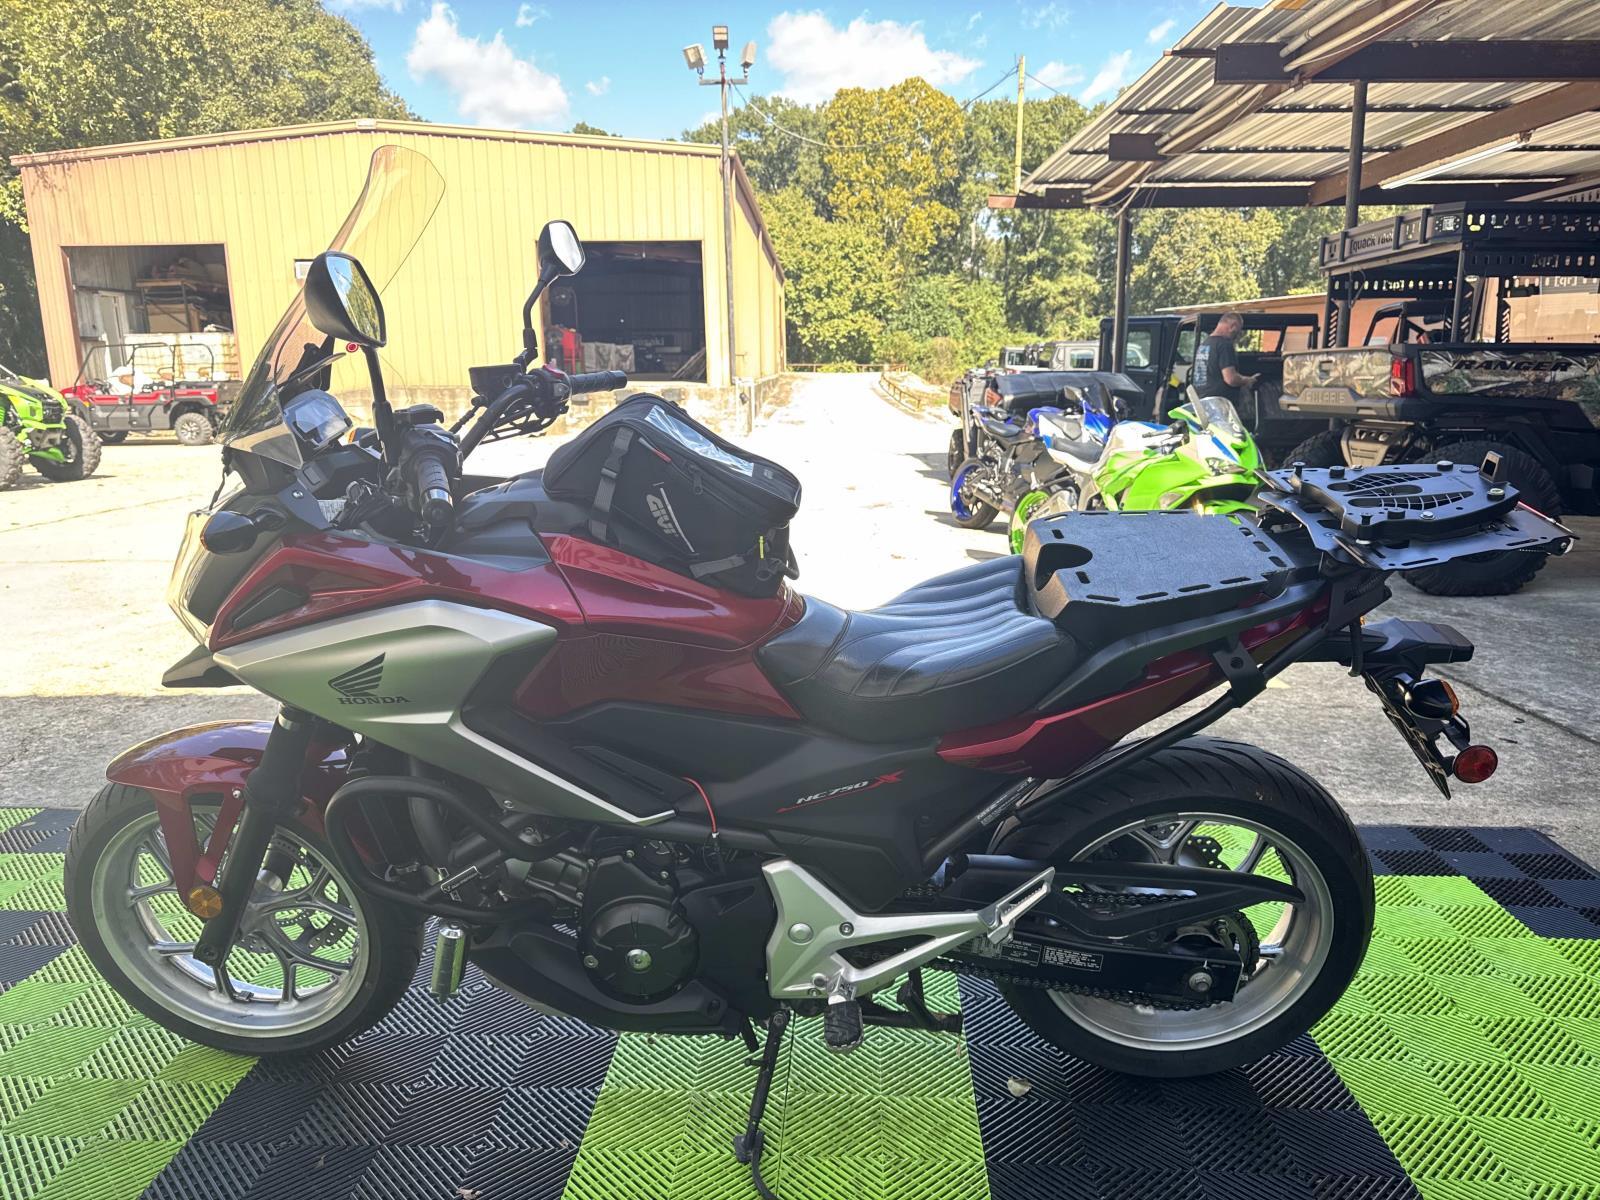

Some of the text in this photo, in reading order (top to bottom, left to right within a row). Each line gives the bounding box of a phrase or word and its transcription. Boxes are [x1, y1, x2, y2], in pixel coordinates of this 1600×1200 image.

[1452, 359, 1570, 372] RANGER
[646, 494, 679, 537] GIVI
[336, 696, 411, 704] HONDA
